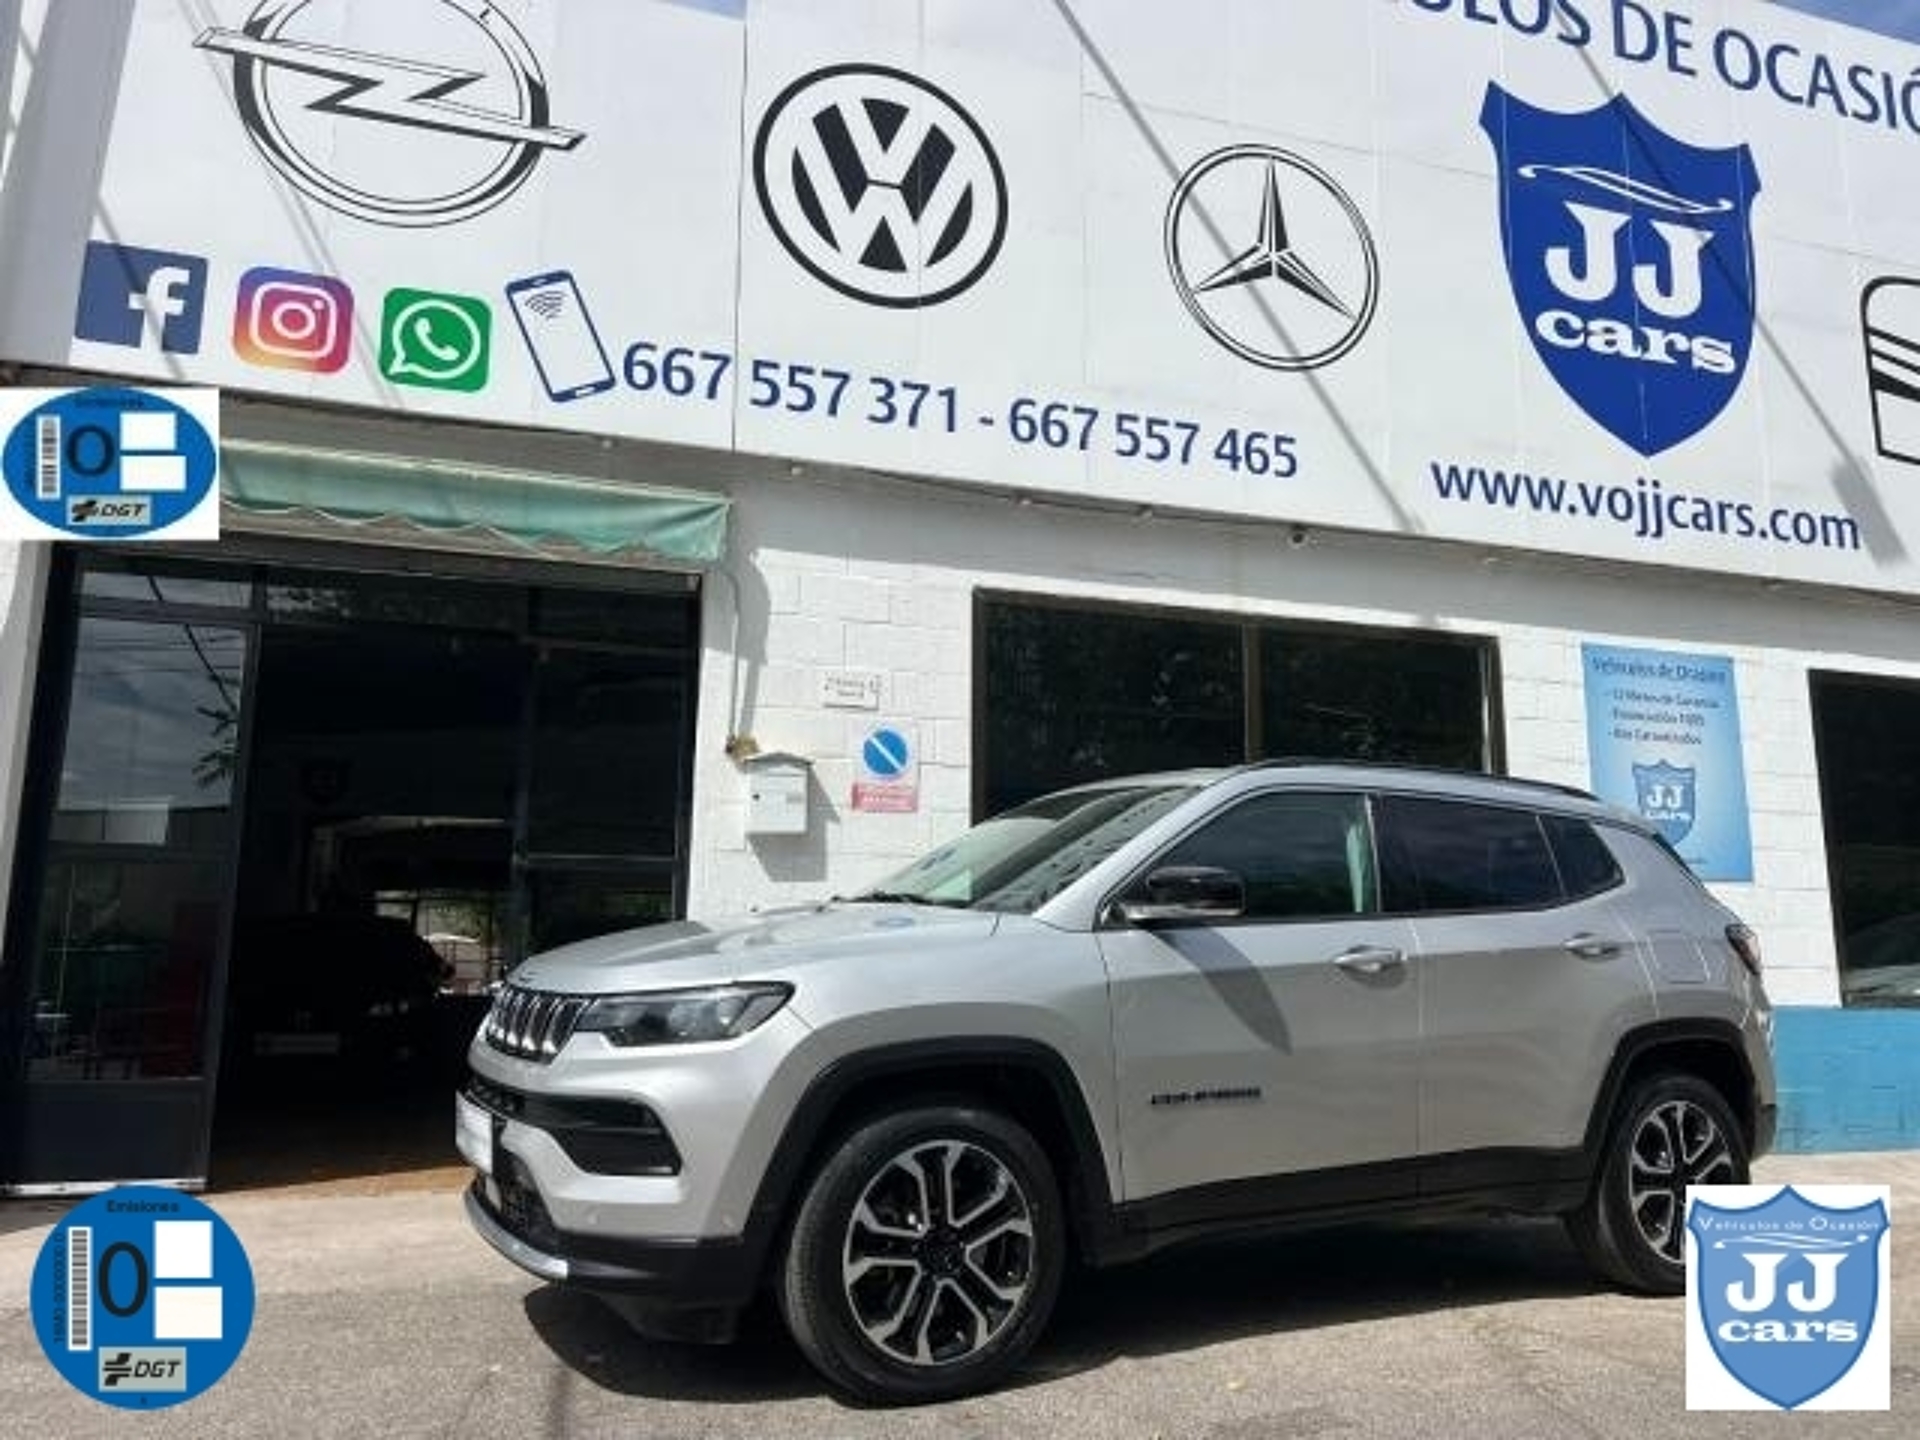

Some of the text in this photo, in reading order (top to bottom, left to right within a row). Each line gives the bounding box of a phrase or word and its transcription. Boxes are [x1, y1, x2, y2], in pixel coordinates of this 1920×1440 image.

[1611, 0, 1697, 77] DE
[1544, 200, 1715, 318] JJ
[1535, 309, 1736, 374] cars
[623, 342, 731, 400] 667
[750, 360, 851, 417] 557
[867, 377, 956, 432] 371
[1009, 398, 1099, 450] 667
[1115, 413, 1200, 464] 557
[1214, 428, 1297, 478] 465
[1431, 461, 1861, 550] www.vojjcars.com
